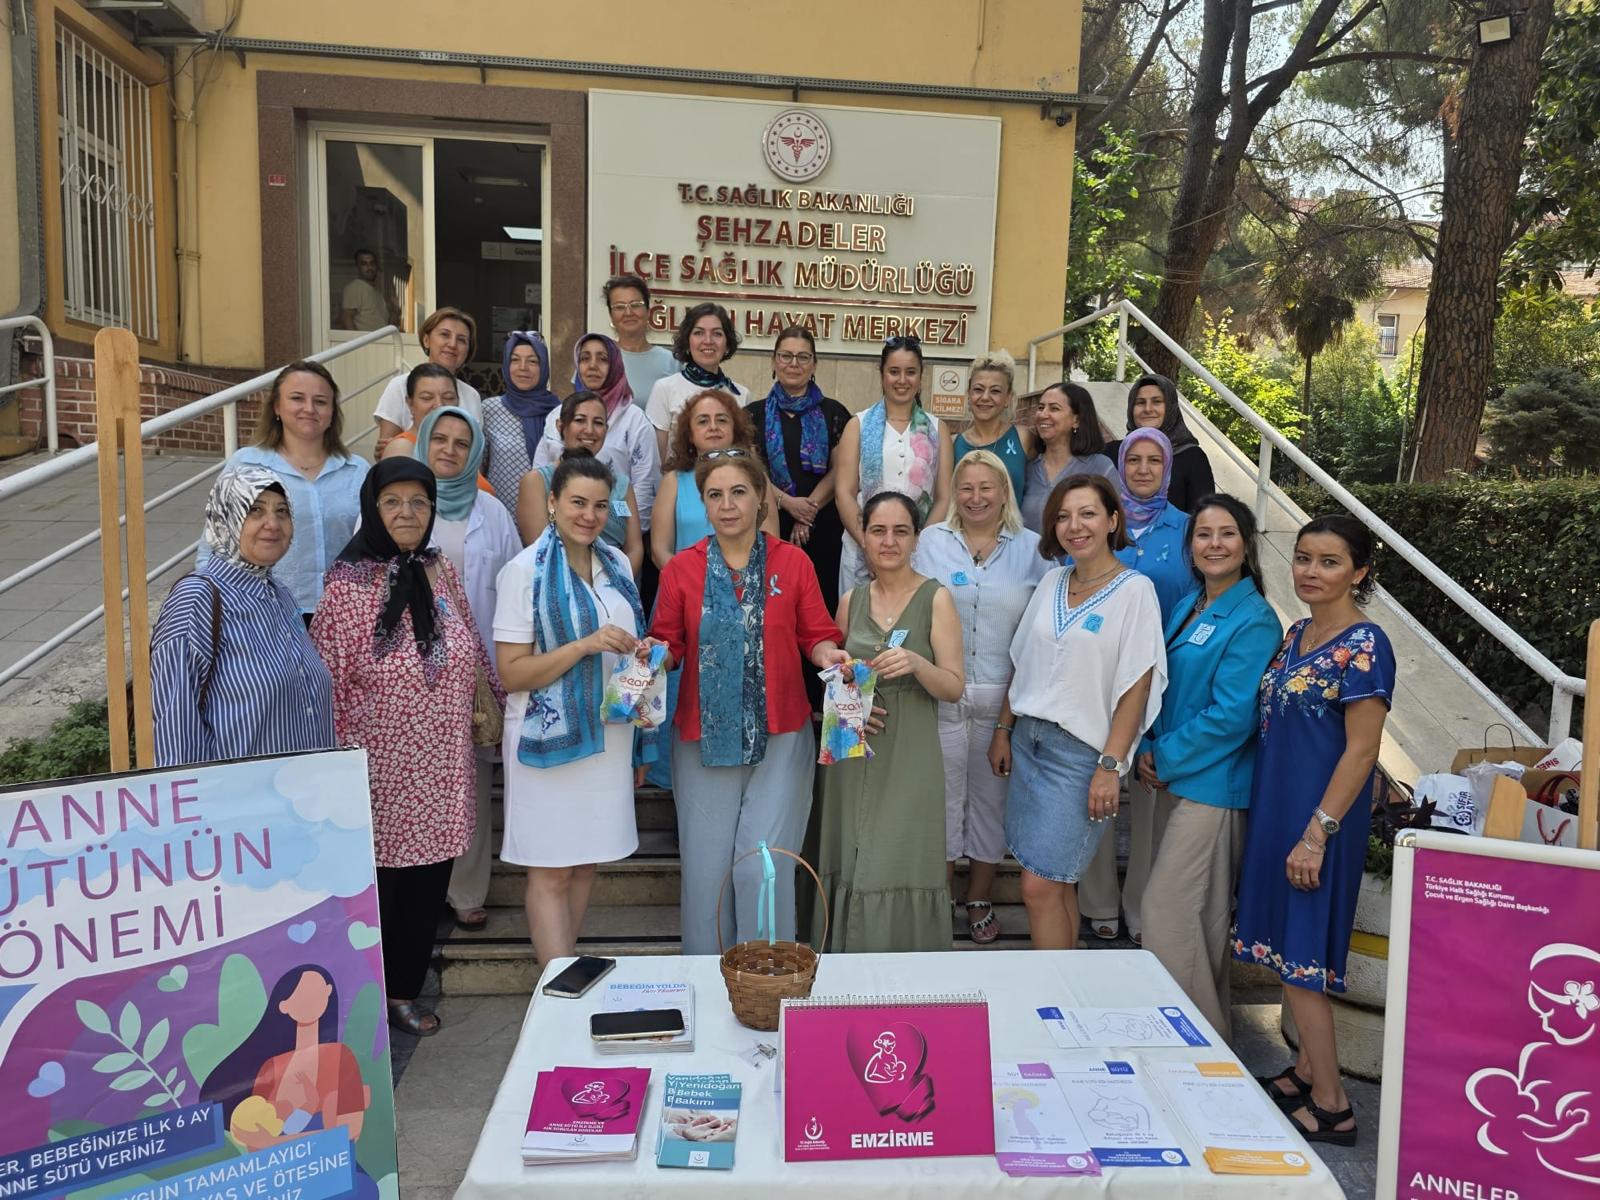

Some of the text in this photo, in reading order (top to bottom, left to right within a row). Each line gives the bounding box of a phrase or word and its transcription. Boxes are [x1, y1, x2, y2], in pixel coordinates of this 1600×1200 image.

[678, 184, 914, 216] T.C. SAĞLIK BAKANLIĞI
[697, 215, 886, 252] ŞEHZADELER
[609, 245, 976, 296] İLÇE SAĞLIK MÜDÜRLÜĞÜ
[744, 309, 836, 340] HAYAT
[842, 312, 968, 346] MERKEZİ
[7, 778, 202, 848] ANNE
[1424, 891, 1444, 899] Çocuk
[1454, 894, 1473, 904] Ergen
[1497, 900, 1516, 909] Daire
[1425, 883, 1448, 892] Türkiye
[1488, 892, 1515, 901] Kurumu
[1439, 877, 1463, 887] SAĞLIK
[1464, 880, 1502, 891] BAKANLIĞI
[0, 885, 225, 979] ÖNEMİ
[675, 1097, 715, 1106] Bakımı
[676, 1089, 713, 1097] Bebek
[679, 1081, 740, 1090] Yenidoğan
[30, 1127, 138, 1168] BEBEĞİNİZE
[144, 1118, 171, 1137] İLK
[176, 1114, 185, 1128] 6
[190, 1107, 211, 1125] AY
[851, 1129, 934, 1148] EMZİRME
[44, 1157, 91, 1185] SÜTÜ
[96, 1139, 166, 1170] VERİNİZ
[184, 1141, 313, 1193] TAMAMLAYICI
[243, 1177, 268, 1197] VE
[274, 1151, 349, 1188] ÖTESİNE
